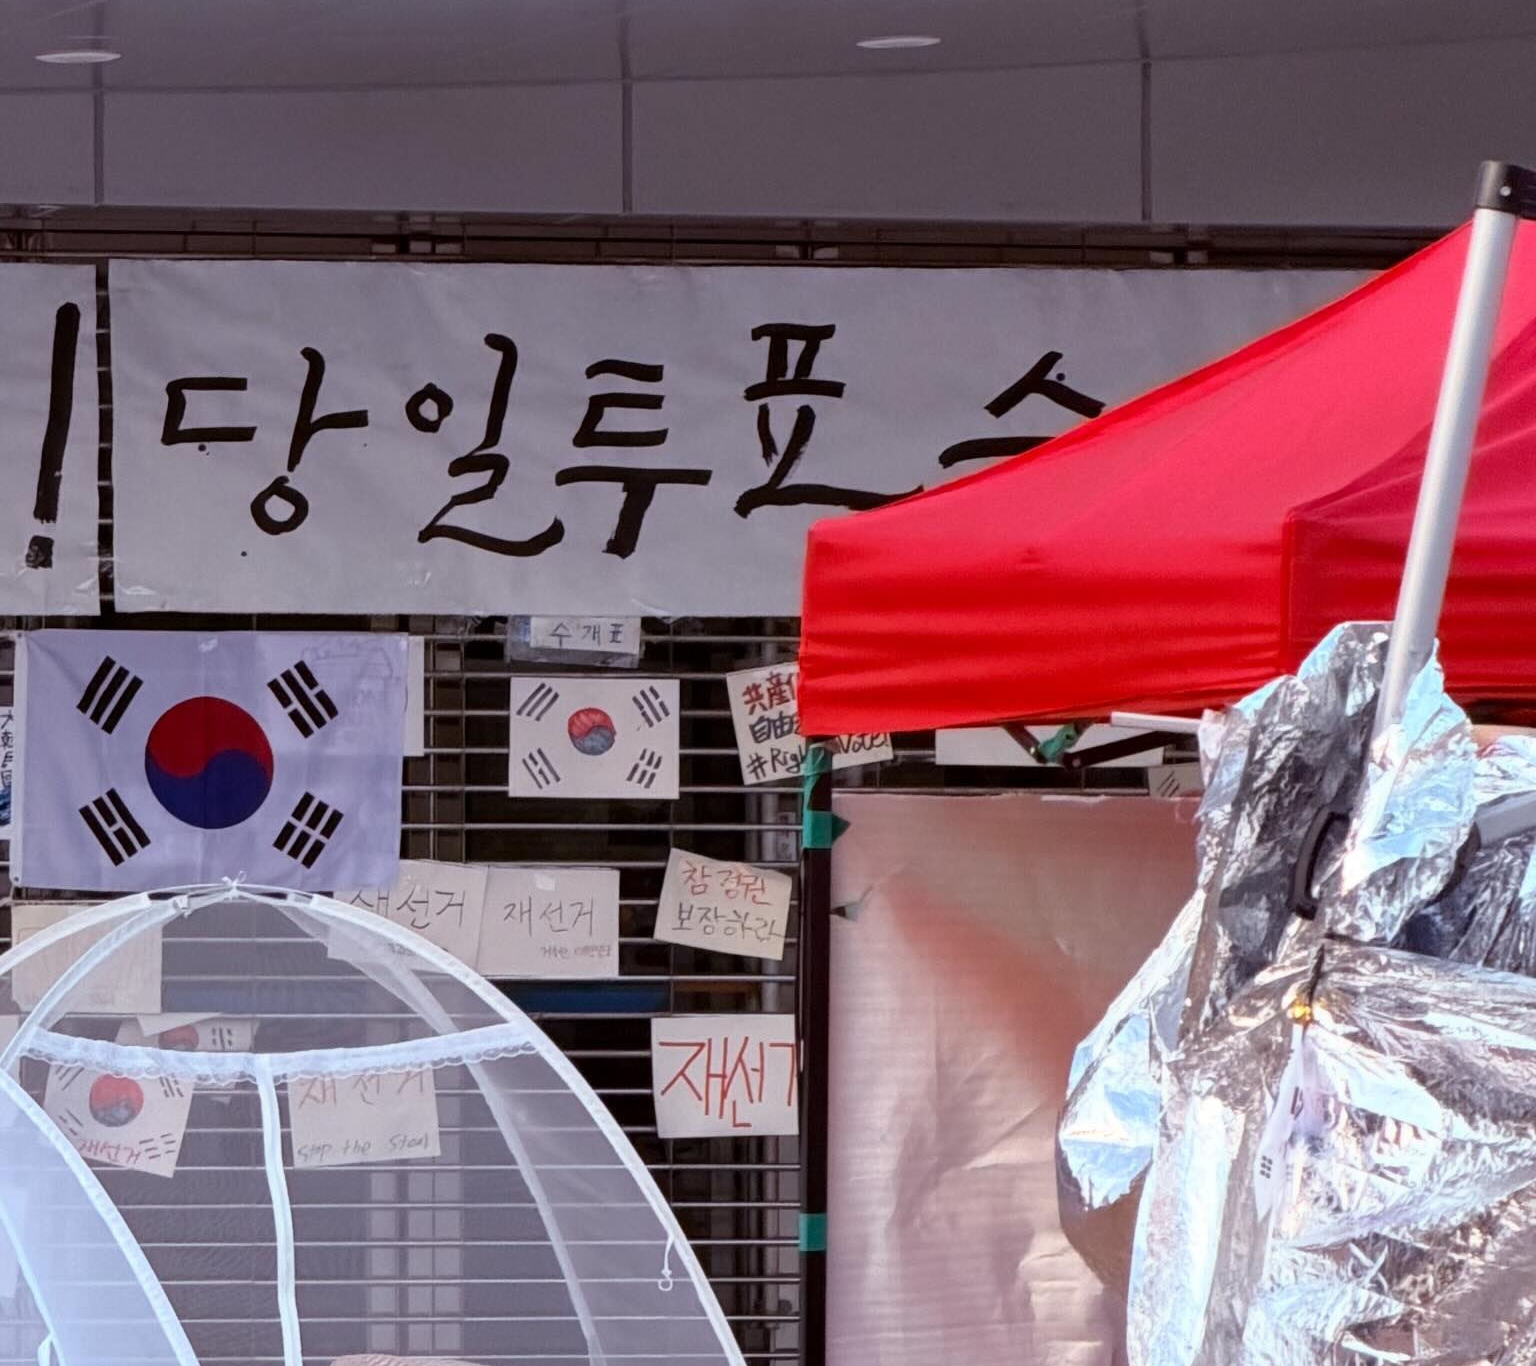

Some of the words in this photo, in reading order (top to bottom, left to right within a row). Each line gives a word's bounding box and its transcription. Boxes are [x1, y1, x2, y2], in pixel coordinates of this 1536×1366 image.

[162, 324, 924, 558] 당일투표
[504, 896, 594, 937] 재선거
[672, 902, 785, 942] 보장하라
